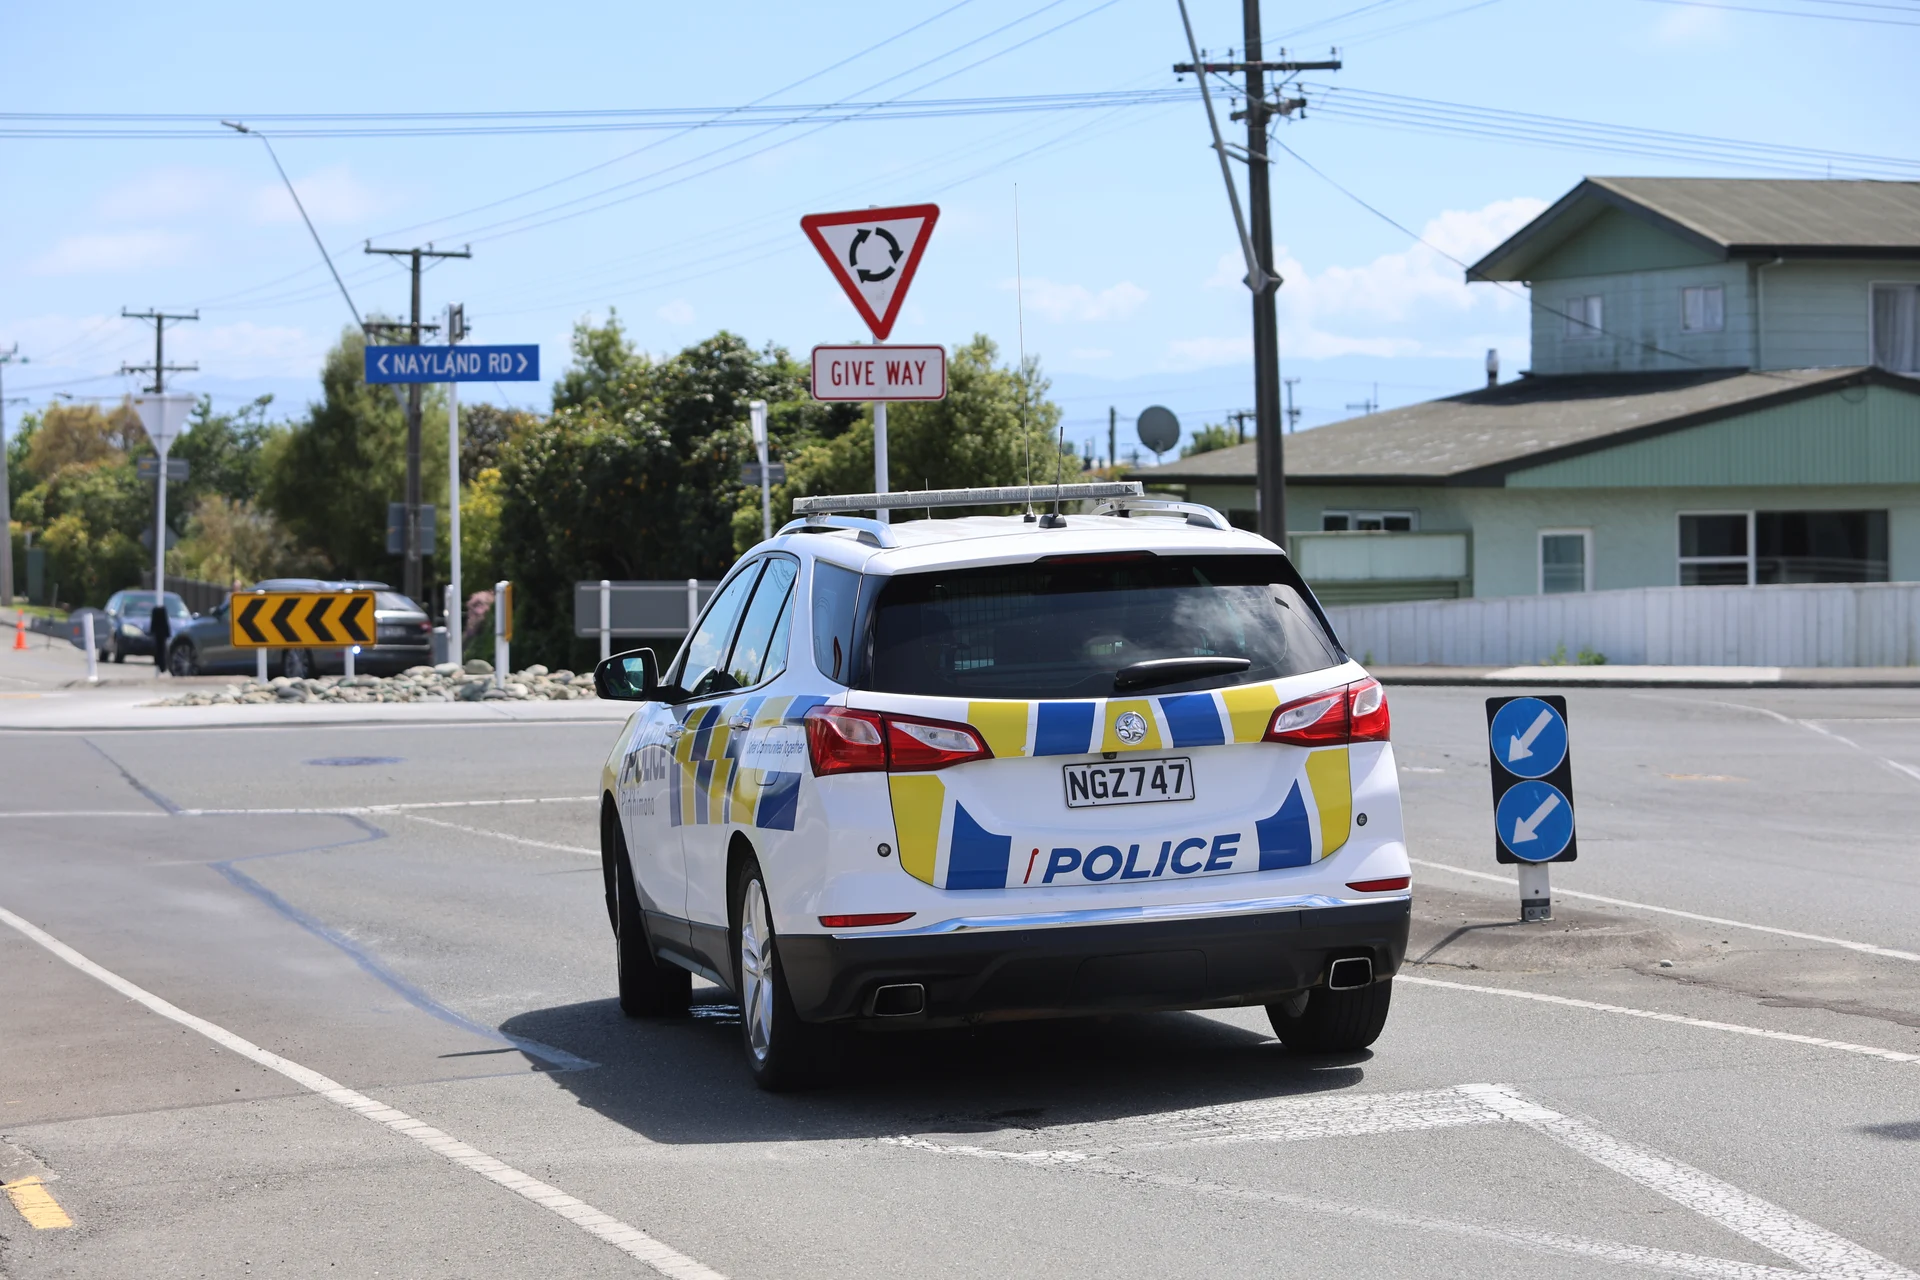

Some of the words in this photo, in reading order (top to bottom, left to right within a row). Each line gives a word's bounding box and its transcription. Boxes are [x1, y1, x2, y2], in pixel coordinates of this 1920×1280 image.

[393, 353, 481, 375] NAYLAND
[488, 353, 513, 374] RD
[831, 360, 875, 386] GIVE
[886, 360, 926, 385] WAY
[1069, 764, 1185, 801] NGZ747
[1042, 833, 1241, 884] POLICE
